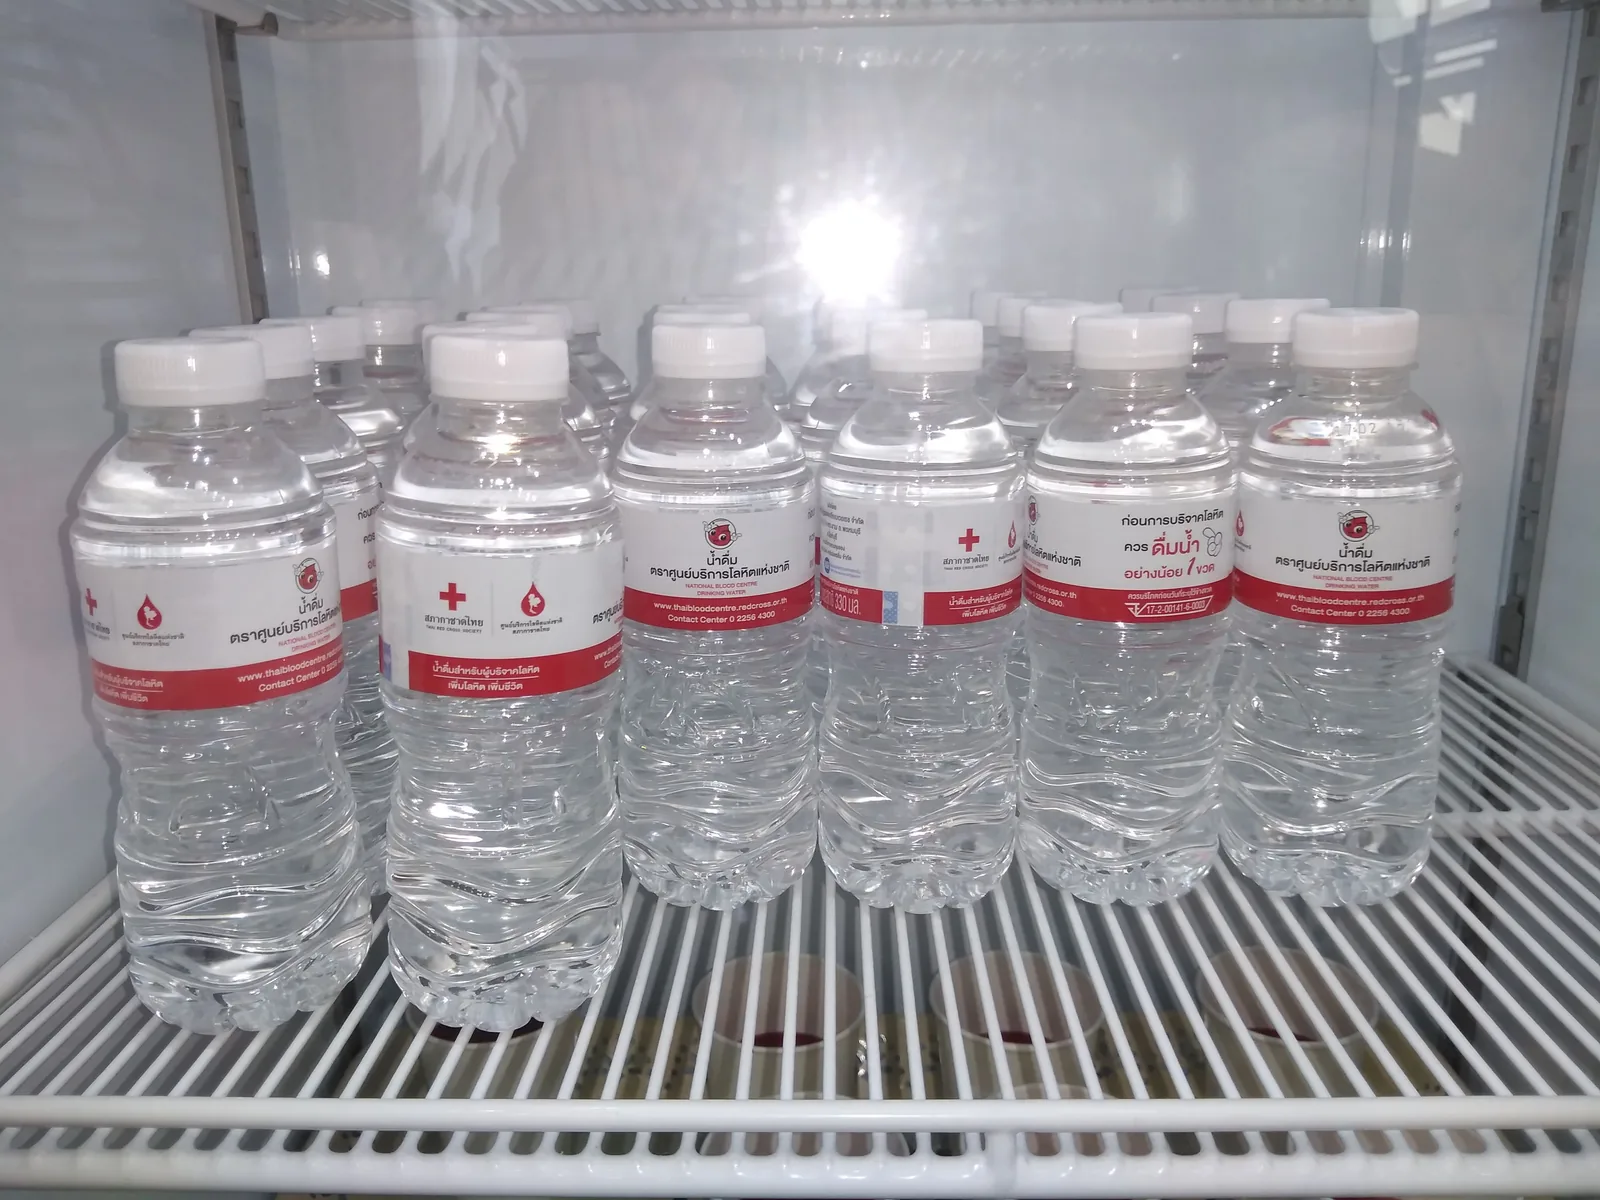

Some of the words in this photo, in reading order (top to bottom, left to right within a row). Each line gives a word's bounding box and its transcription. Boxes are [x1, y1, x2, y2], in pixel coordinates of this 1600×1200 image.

[1122, 508, 1224, 526] ก่อนการบริจาคโลหิต
[1124, 543, 1148, 552] ควร
[1152, 529, 1200, 556] ดื่มน้ำ
[1339, 542, 1373, 558] น้ำดื่ม
[706, 551, 738, 566] น้ำดื่ม
[943, 554, 990, 565] สภากาชาดไทย
[1275, 556, 1431, 573] ตราศูนย์บริการโลหิตแห่งชาติ
[650, 560, 790, 582] ตราศูนย์บริการโลหิตแห่งชาติ
[1124, 565, 1183, 579] อย่างน้อย
[1187, 557, 1196, 575] 1
[1196, 563, 1215, 575] ขวด
[299, 593, 324, 614] น้ำดื่ม
[653, 597, 788, 613] www.thaibloodcentre.redcross.or.th
[1276, 591, 1425, 606] www.thaibloodcentre.redcross.or.th
[668, 614, 698, 623] Contact
[700, 615, 728, 623] Center
[729, 615, 735, 623] 0
[736, 613, 756, 622] 2256
[757, 610, 776, 619] 4300
[1291, 605, 1324, 616] Contact
[1326, 608, 1357, 617] Center
[1358, 609, 1365, 617] 0
[1366, 609, 1388, 617] 2256
[1389, 607, 1411, 616] 4300
[424, 614, 484, 627] สภากาชาดไทย
[278, 634, 307, 647] NATIONAL
[432, 661, 540, 678] น้ำดื่มสำหรับผู้บริจาคโลหิต
[258, 678, 295, 692] Contact
[296, 669, 320, 684] Center
[448, 680, 486, 692] เพิ่มโลหิต
[487, 680, 523, 692] เพิ่มชีวิต
